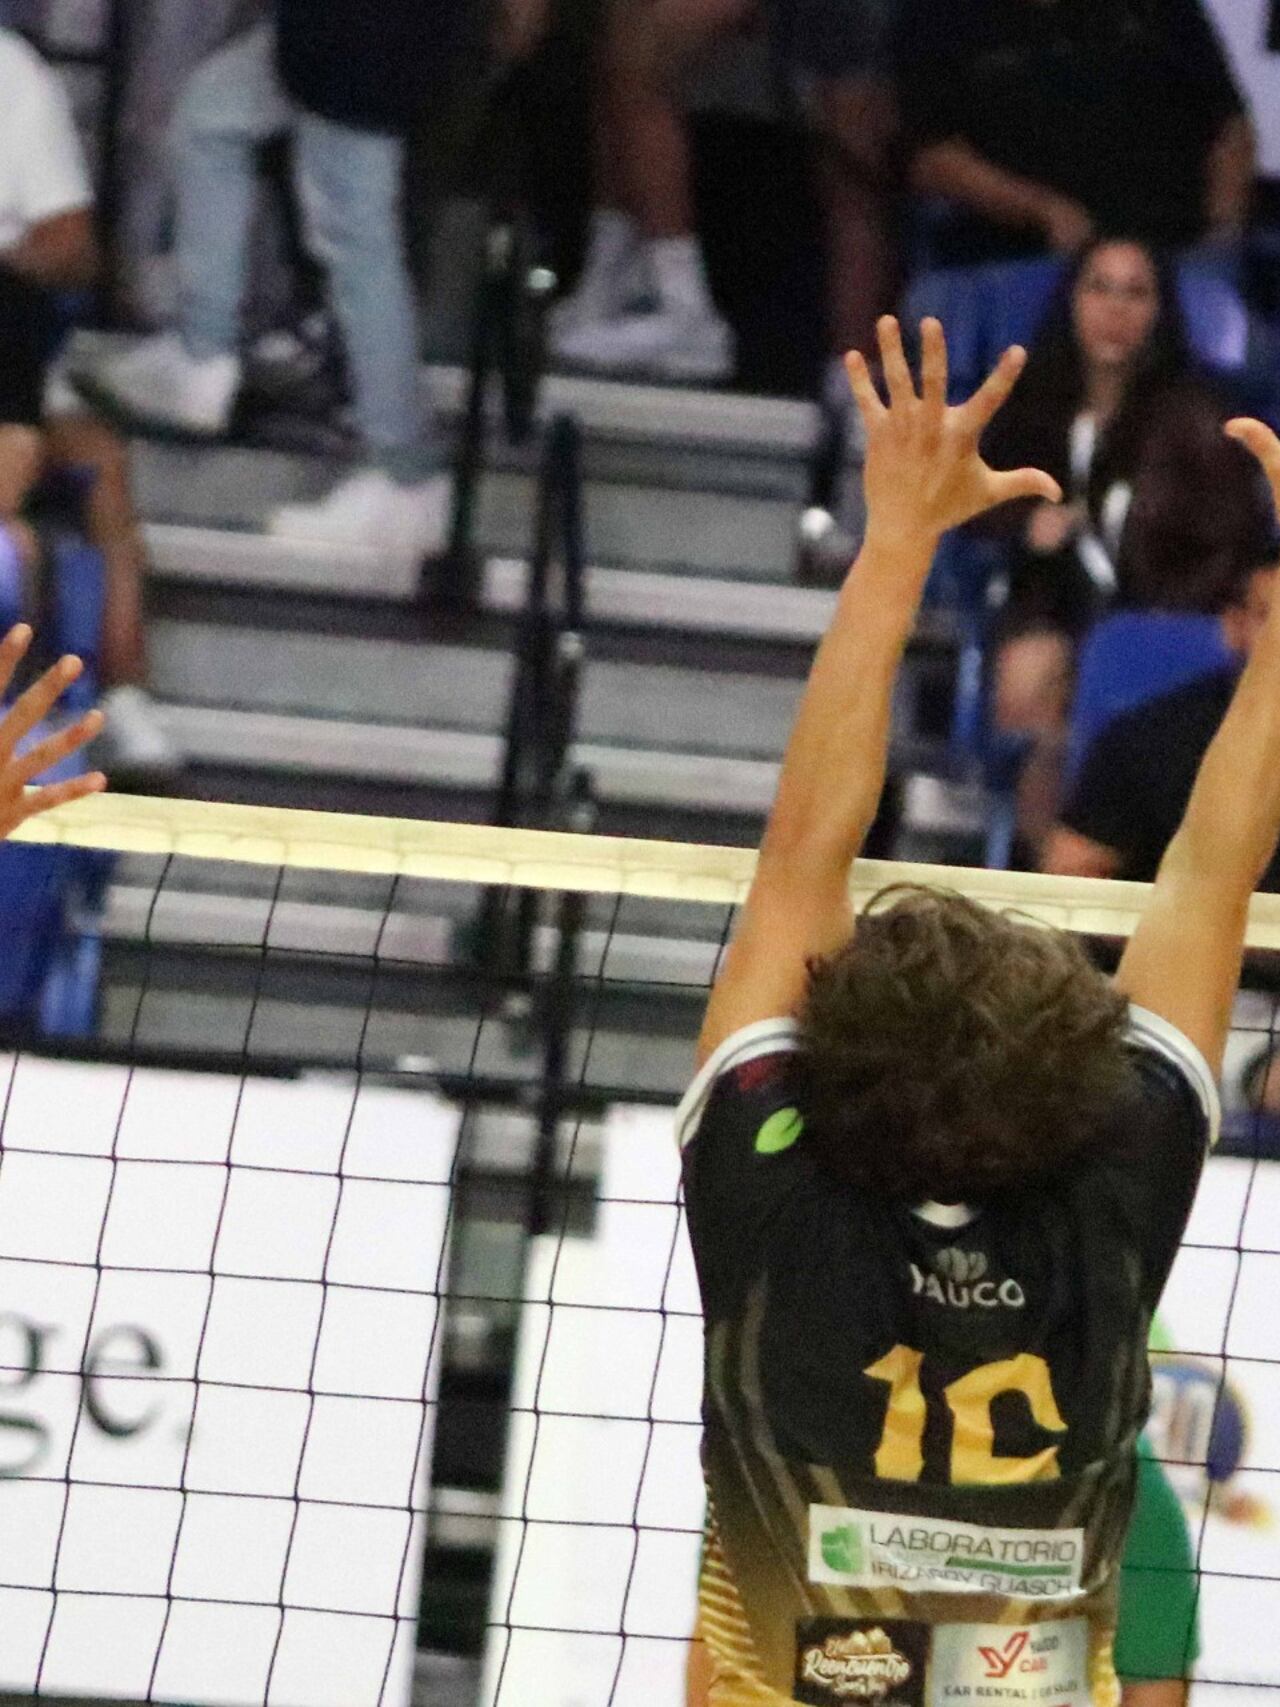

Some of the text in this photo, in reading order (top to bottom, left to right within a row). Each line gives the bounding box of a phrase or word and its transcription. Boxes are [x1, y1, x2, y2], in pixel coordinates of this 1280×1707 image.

[862, 1343, 1069, 1487] 10
[869, 1522, 1077, 1563] LABORATORIO
[975, 1686, 1029, 1699] RENTAL
